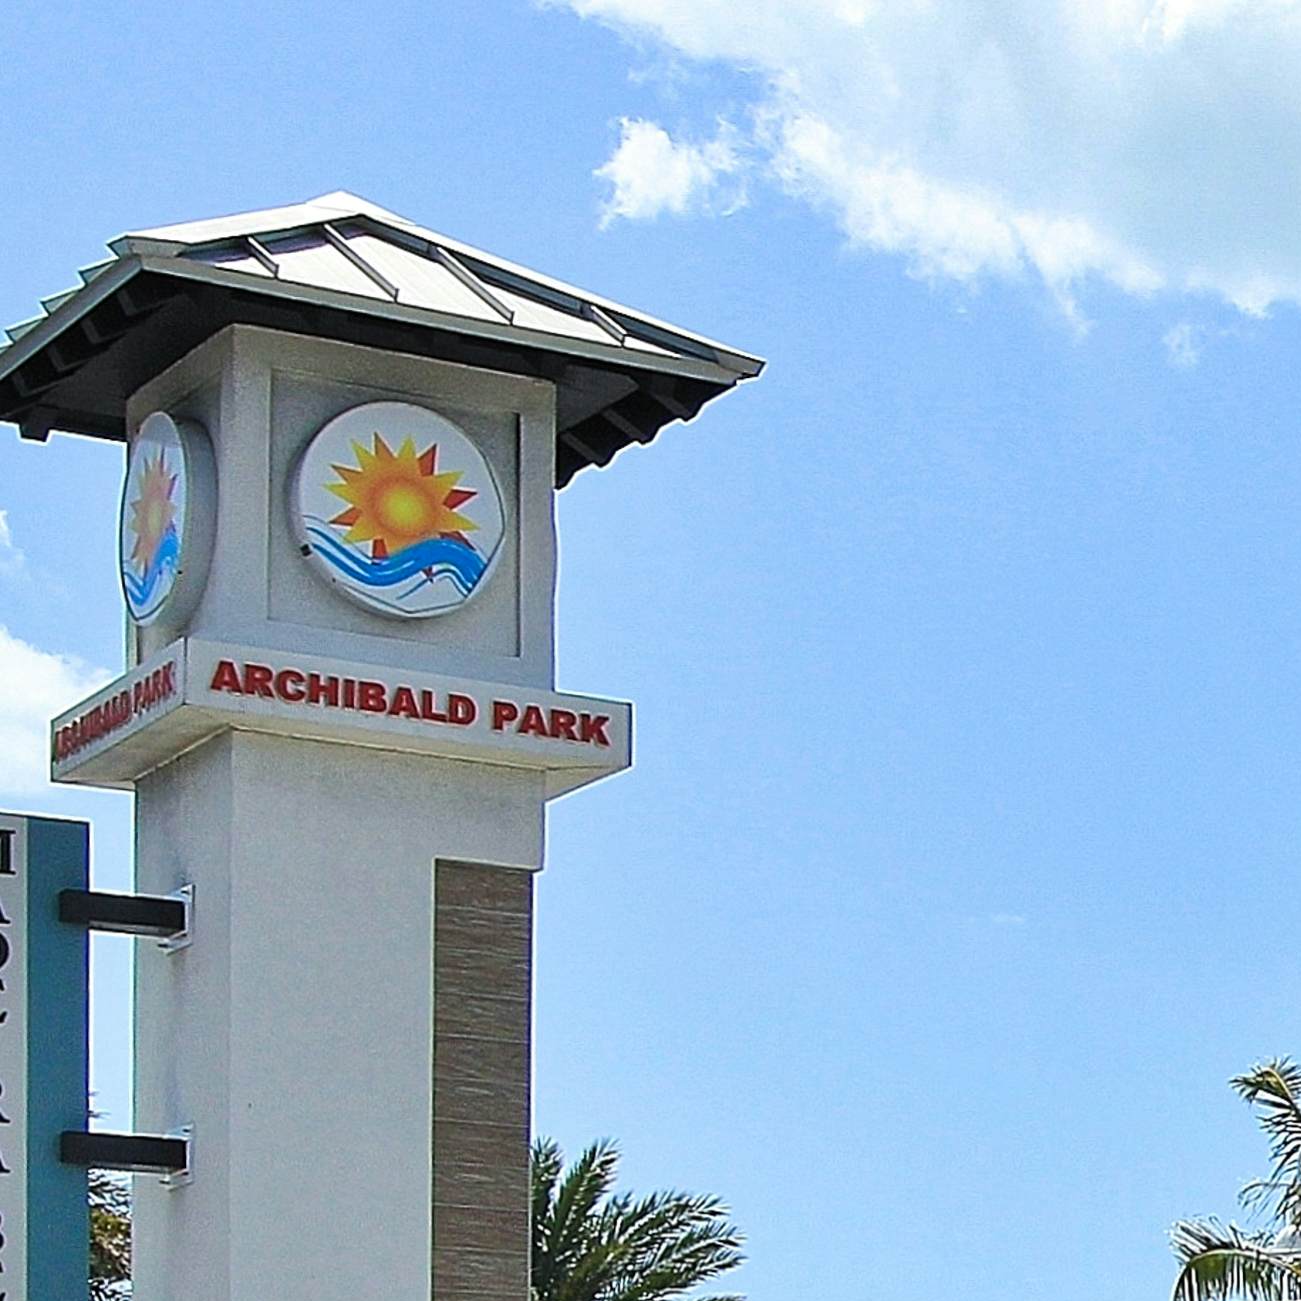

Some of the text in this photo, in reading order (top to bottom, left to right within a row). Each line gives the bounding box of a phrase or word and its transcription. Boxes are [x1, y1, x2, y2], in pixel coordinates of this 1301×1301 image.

[133, 661, 177, 713] PARK
[210, 660, 612, 747] ARCHIBALD PARK
